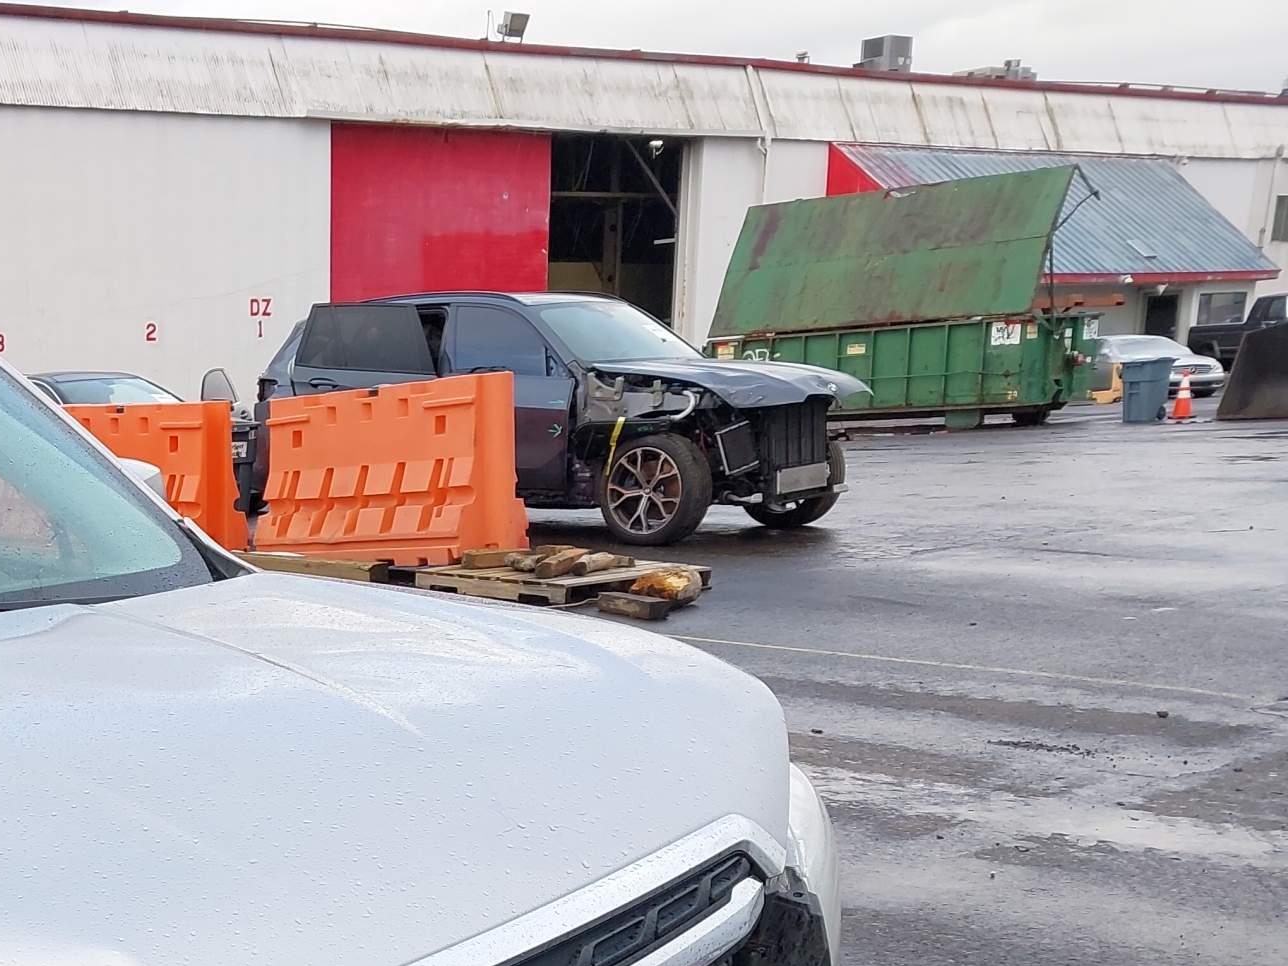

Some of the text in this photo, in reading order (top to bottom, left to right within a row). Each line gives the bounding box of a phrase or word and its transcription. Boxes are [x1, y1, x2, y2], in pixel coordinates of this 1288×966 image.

[249, 298, 272, 318] DZ
[145, 323, 157, 342] 2
[257, 320, 264, 339] 1
